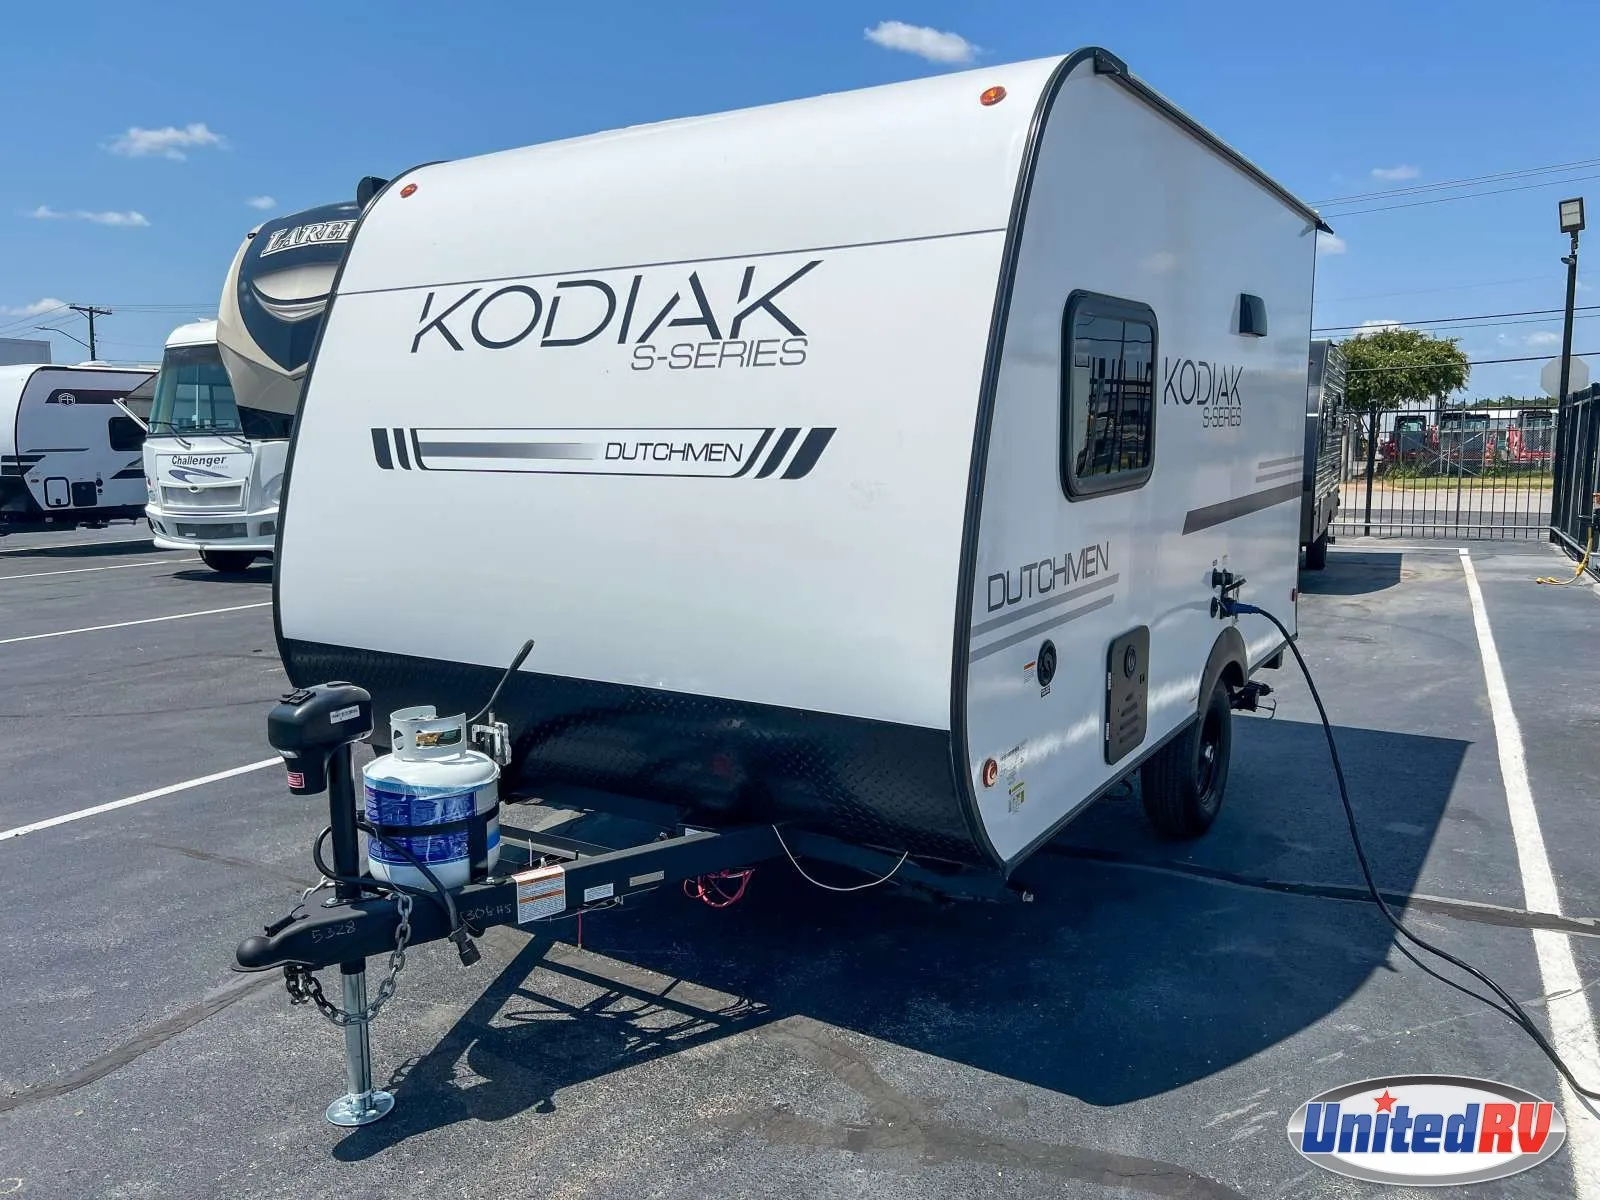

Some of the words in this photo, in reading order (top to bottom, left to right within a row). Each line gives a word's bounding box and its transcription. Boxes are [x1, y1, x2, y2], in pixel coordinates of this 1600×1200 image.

[410, 259, 824, 353] KODIAK
[630, 337, 808, 371] S-SERIES
[1163, 356, 1244, 406] KODIAK
[1202, 406, 1242, 428] S-SERIES
[171, 455, 227, 467] Challenger
[604, 442, 744, 463] DUTCHMEN
[987, 541, 1110, 613] DUTCHMEN
[311, 919, 356, 944] 5328
